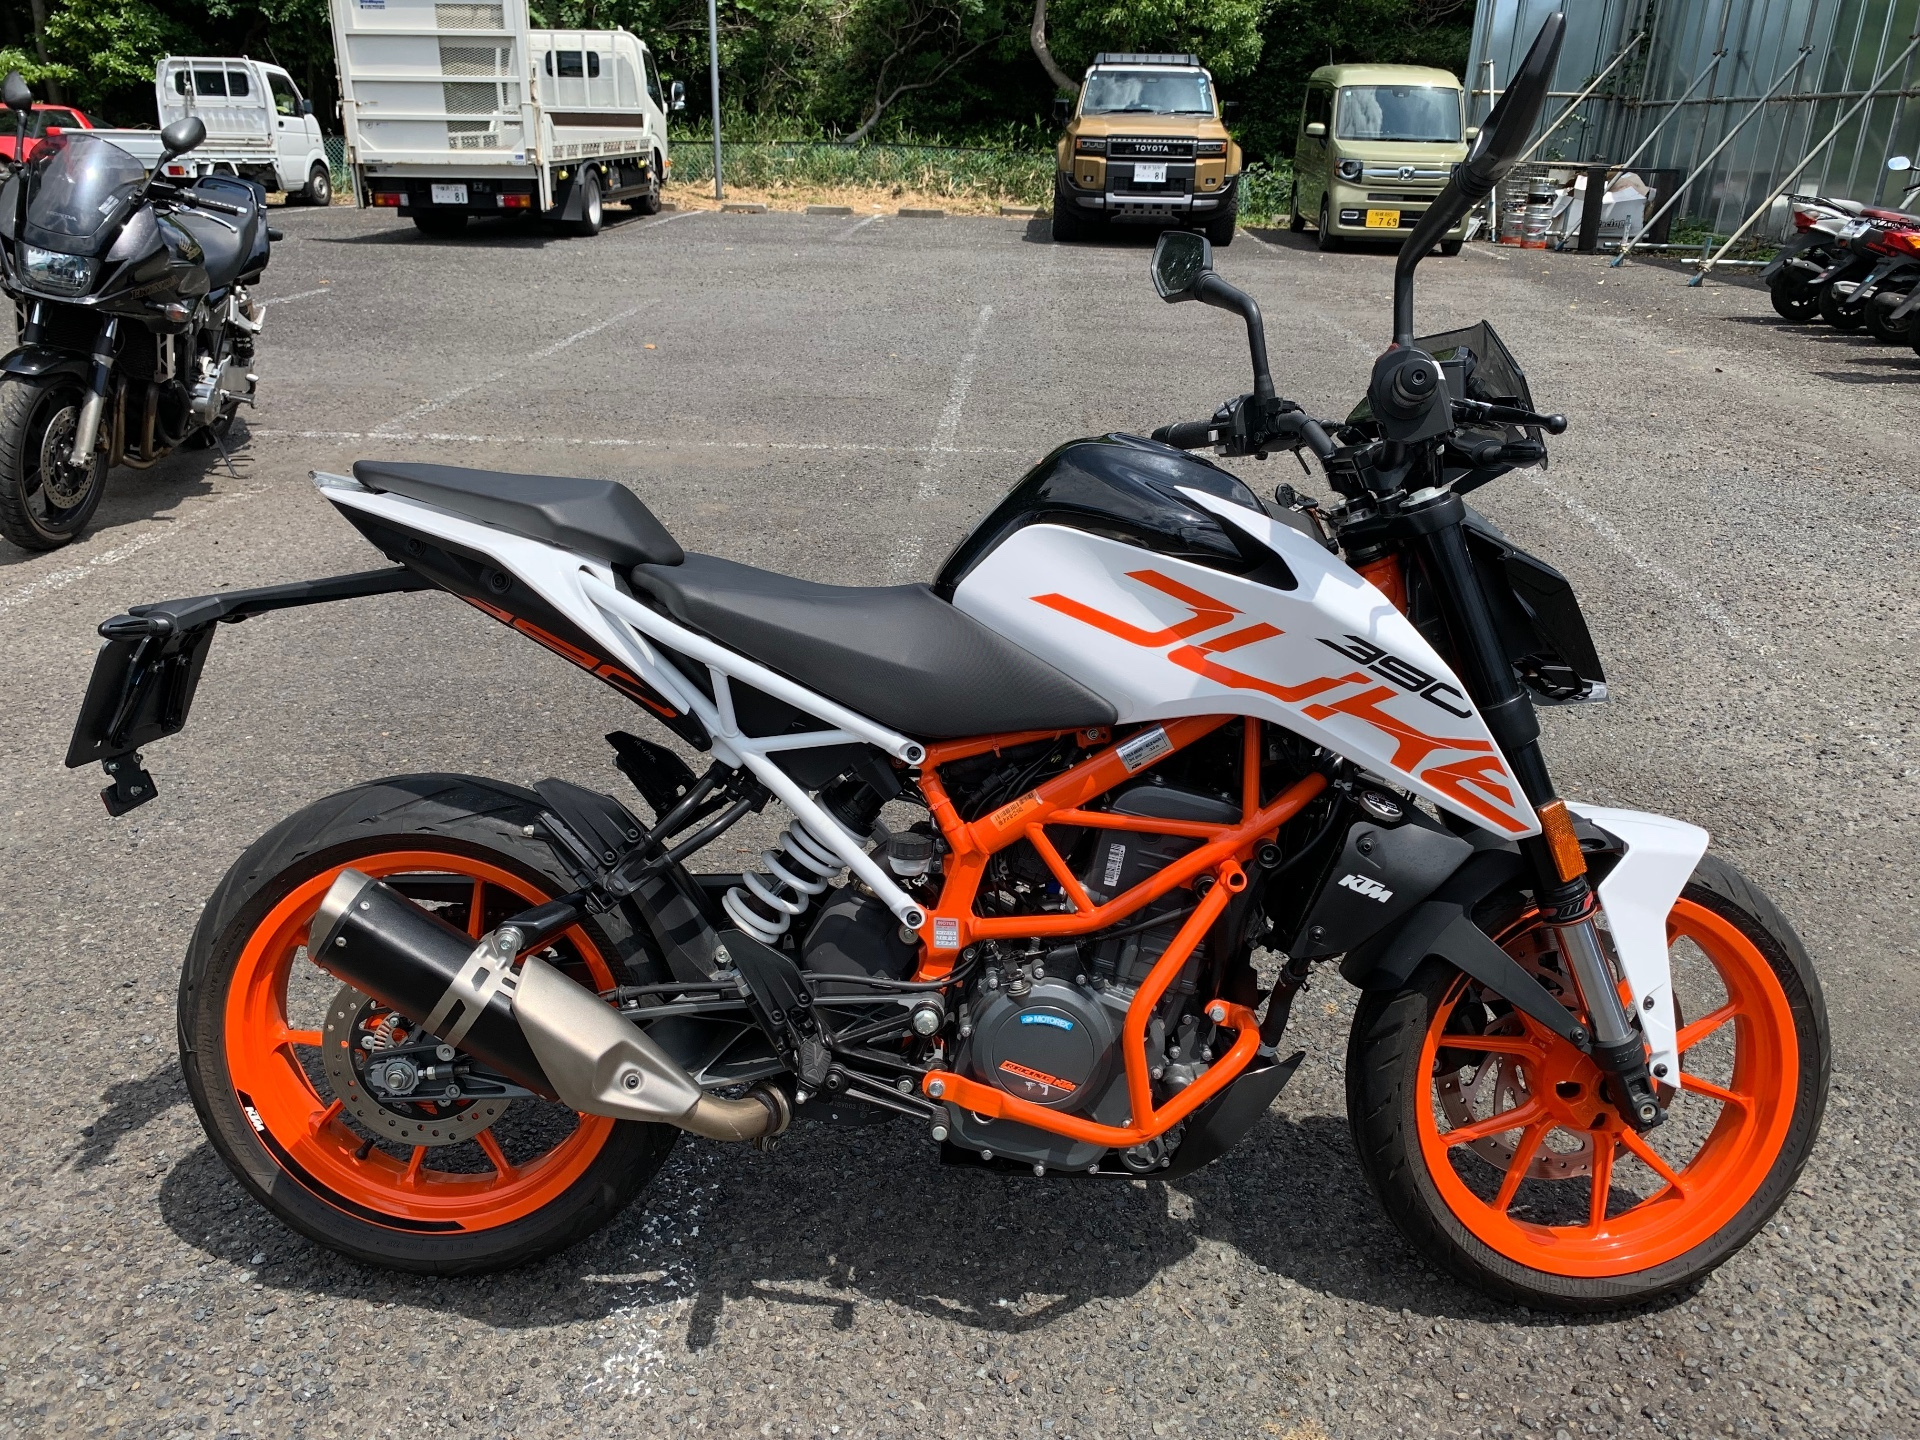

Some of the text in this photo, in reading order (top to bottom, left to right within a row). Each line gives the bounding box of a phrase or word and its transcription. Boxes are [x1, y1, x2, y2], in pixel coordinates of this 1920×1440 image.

[1134, 144, 1169, 152] TOYOTA
[1028, 569, 1530, 833] DUKE
[1337, 874, 1394, 904] KTM
[1033, 1015, 1071, 1030] MOTOREX
[1003, 1062, 1052, 1083] RACING
[244, 1106, 265, 1132] KTM
